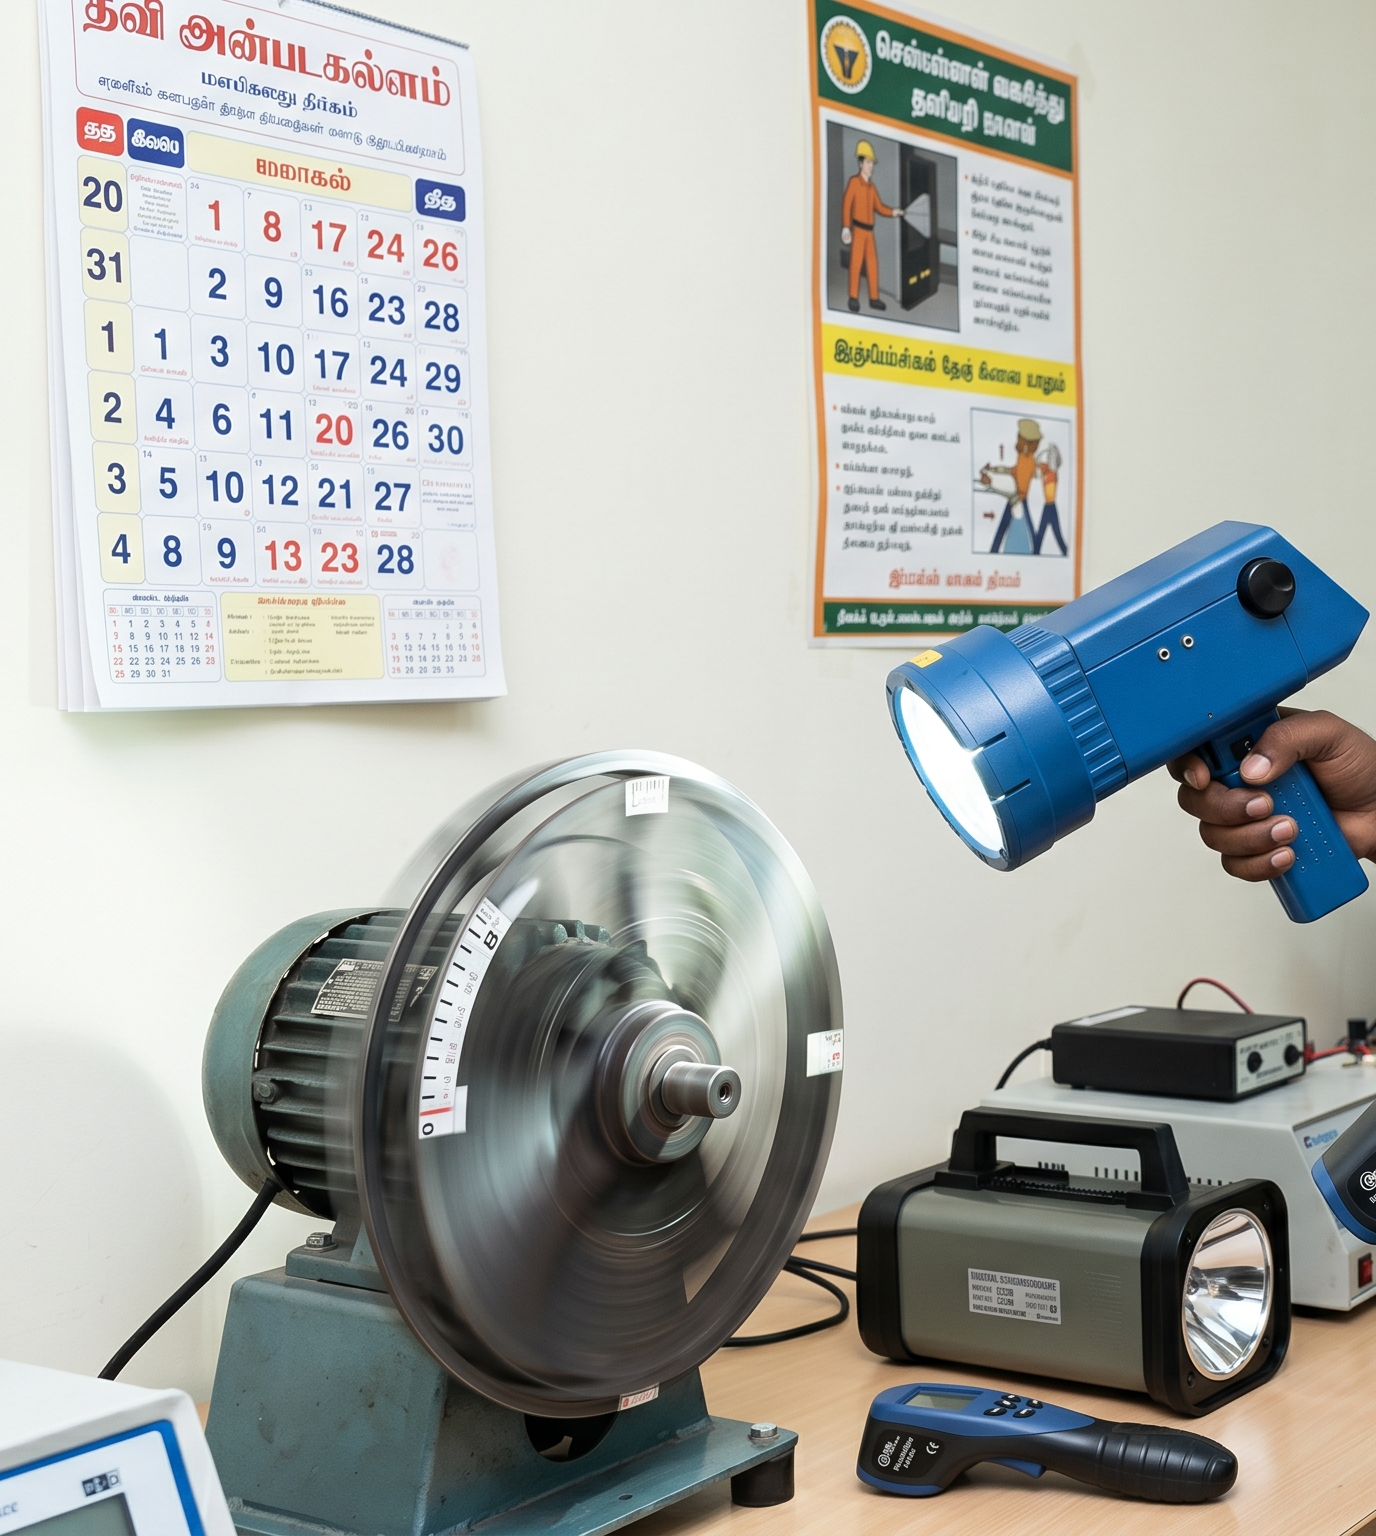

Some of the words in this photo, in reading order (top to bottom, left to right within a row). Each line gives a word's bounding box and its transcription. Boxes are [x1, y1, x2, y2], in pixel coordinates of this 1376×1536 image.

[82, 175, 123, 213] 20
[208, 199, 221, 232] 1
[263, 210, 282, 243] 8
[311, 219, 347, 253] 17
[367, 229, 405, 263] 24
[422, 238, 459, 272] 26
[86, 247, 122, 284] 31
[208, 267, 227, 301] 2
[264, 276, 283, 309] 9
[312, 284, 349, 318] 16
[368, 292, 406, 326] 23
[424, 300, 460, 333] 28
[101, 320, 115, 353] 1
[154, 328, 168, 361] 1
[210, 334, 230, 368] 3
[257, 341, 295, 376] 10
[314, 348, 350, 381] 17
[370, 355, 408, 388] 24
[425, 361, 461, 394] 29
[103, 391, 123, 424] 2
[155, 397, 176, 430] 4
[212, 402, 232, 436] 6
[259, 408, 292, 441] 11
[315, 413, 354, 446] 20
[372, 418, 410, 451] 26
[428, 423, 464, 456] 30
[142, 450, 153, 458] 14
[107, 462, 127, 495] 3
[158, 466, 178, 500] 5
[205, 470, 244, 504] 10
[261, 474, 299, 507] 12
[318, 477, 352, 510] 21
[374, 481, 412, 512] 27
[111, 533, 131, 564] 4
[163, 534, 183, 568] 8
[217, 537, 237, 570] 9
[264, 539, 302, 572] 13
[320, 541, 359, 574] 23
[377, 543, 415, 575] 28
[130, 632, 134, 640] 8
[145, 632, 150, 640] 9
[159, 632, 168, 640] 10
[175, 632, 183, 640] 11
[190, 632, 198, 640] 12
[205, 632, 213, 640] 14
[114, 657, 123, 665] 22
[130, 657, 139, 665] 22
[145, 657, 155, 665] 23
[161, 657, 170, 665] 24
[176, 657, 185, 665] 25
[191, 657, 200, 665] 26
[131, 670, 140, 678] 29
[146, 670, 156, 678] 30
[162, 670, 171, 678] 31
